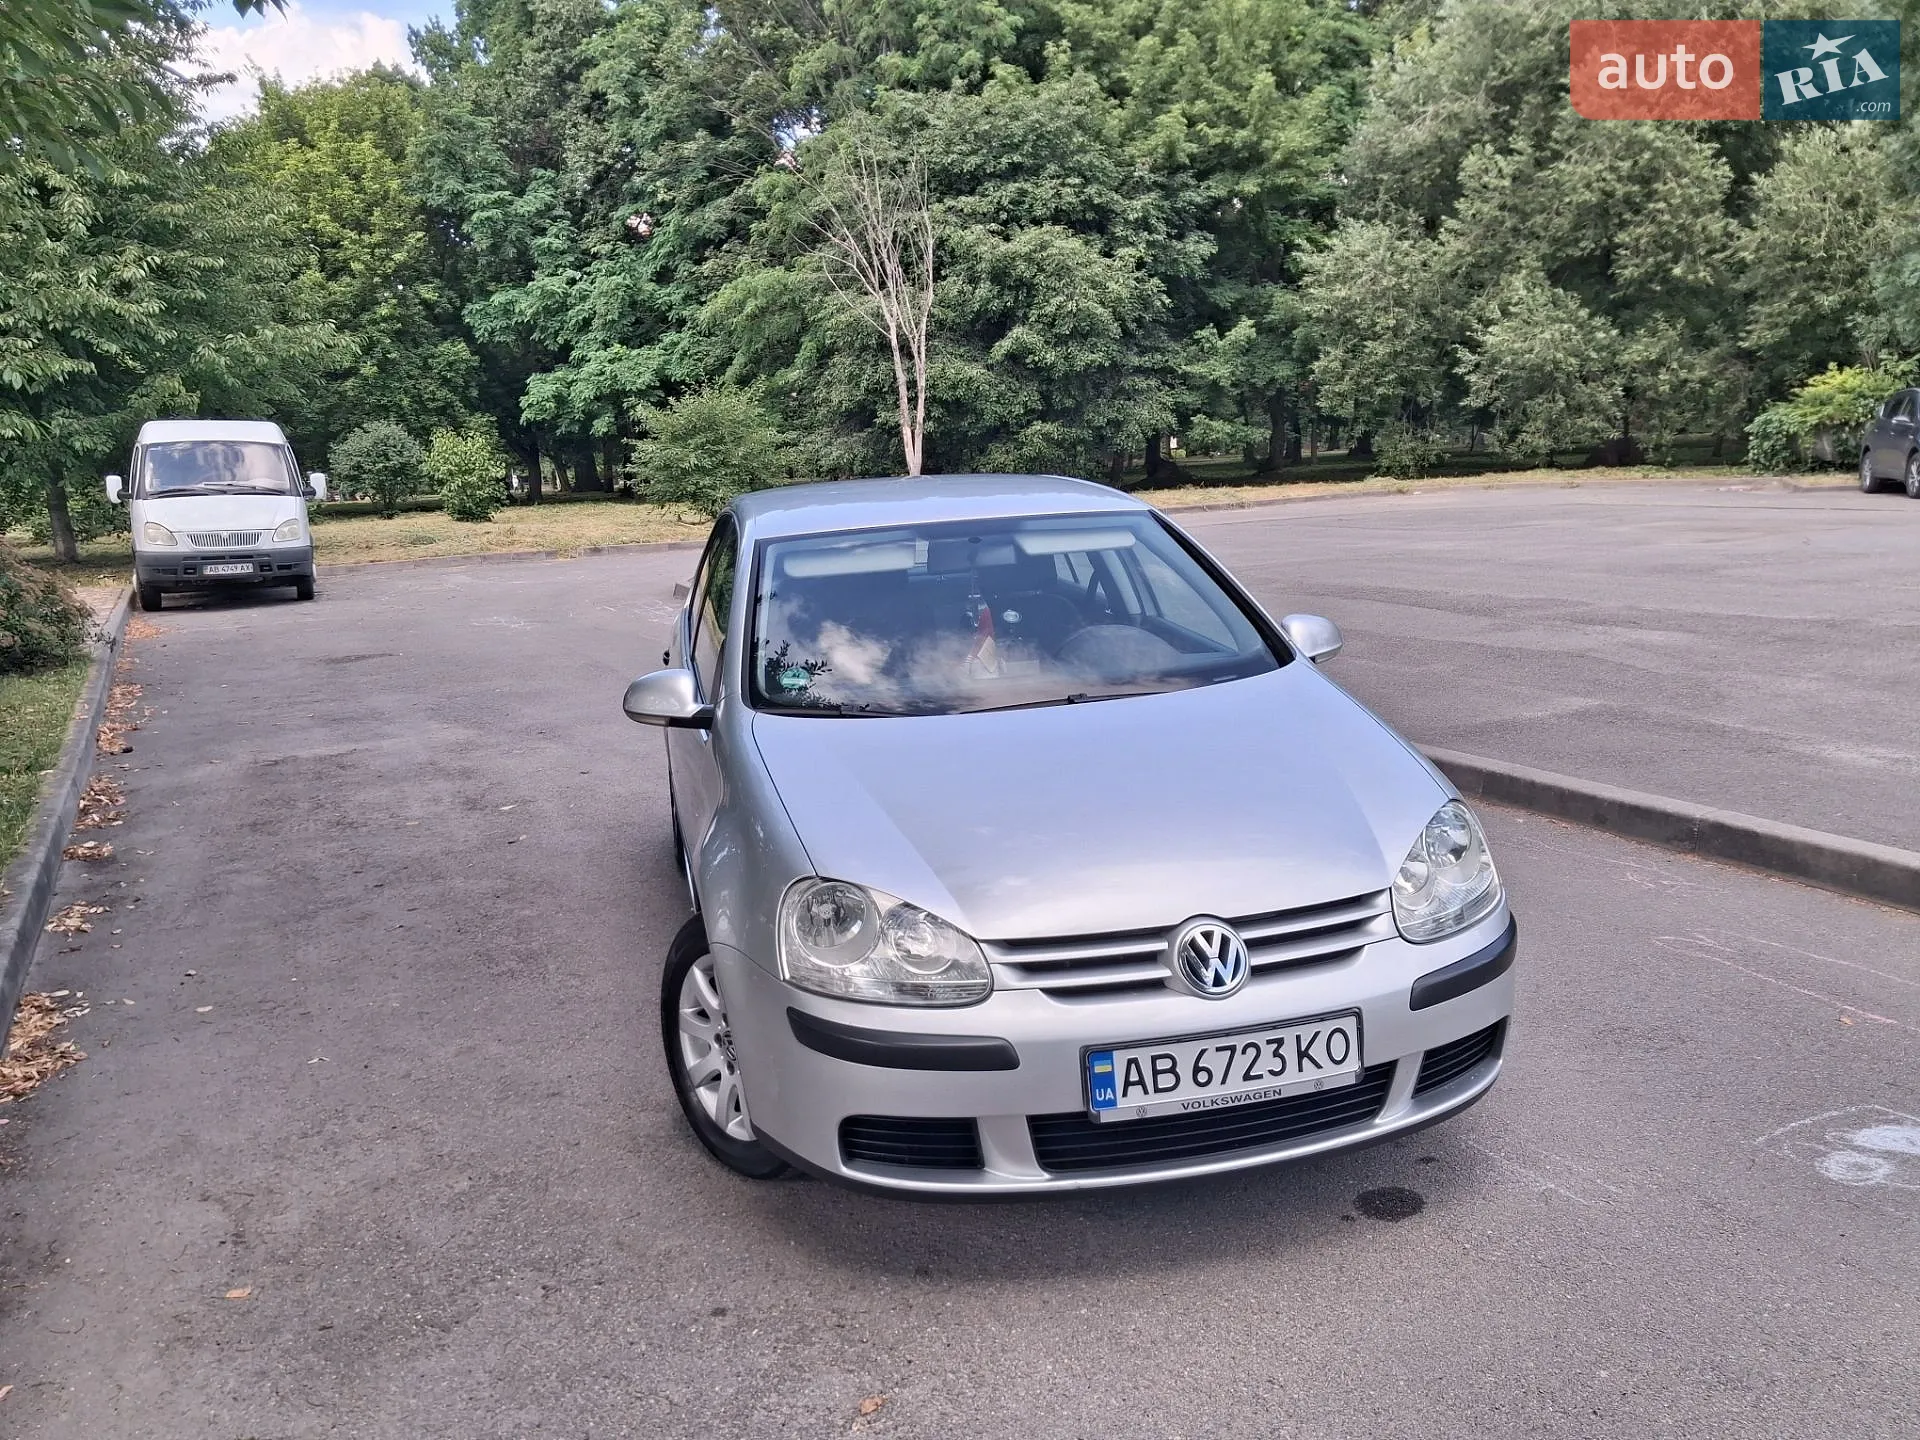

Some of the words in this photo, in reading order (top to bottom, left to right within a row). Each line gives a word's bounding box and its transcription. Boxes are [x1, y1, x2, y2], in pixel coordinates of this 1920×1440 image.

[1180, 925, 1247, 993] VW
[1121, 1052, 1181, 1098] AB
[1191, 1037, 1287, 1088] 6723
[1295, 1026, 1351, 1073] KO
[1095, 1087, 1115, 1101] UA
[1180, 1088, 1283, 1111] VOLKSWAGEN
